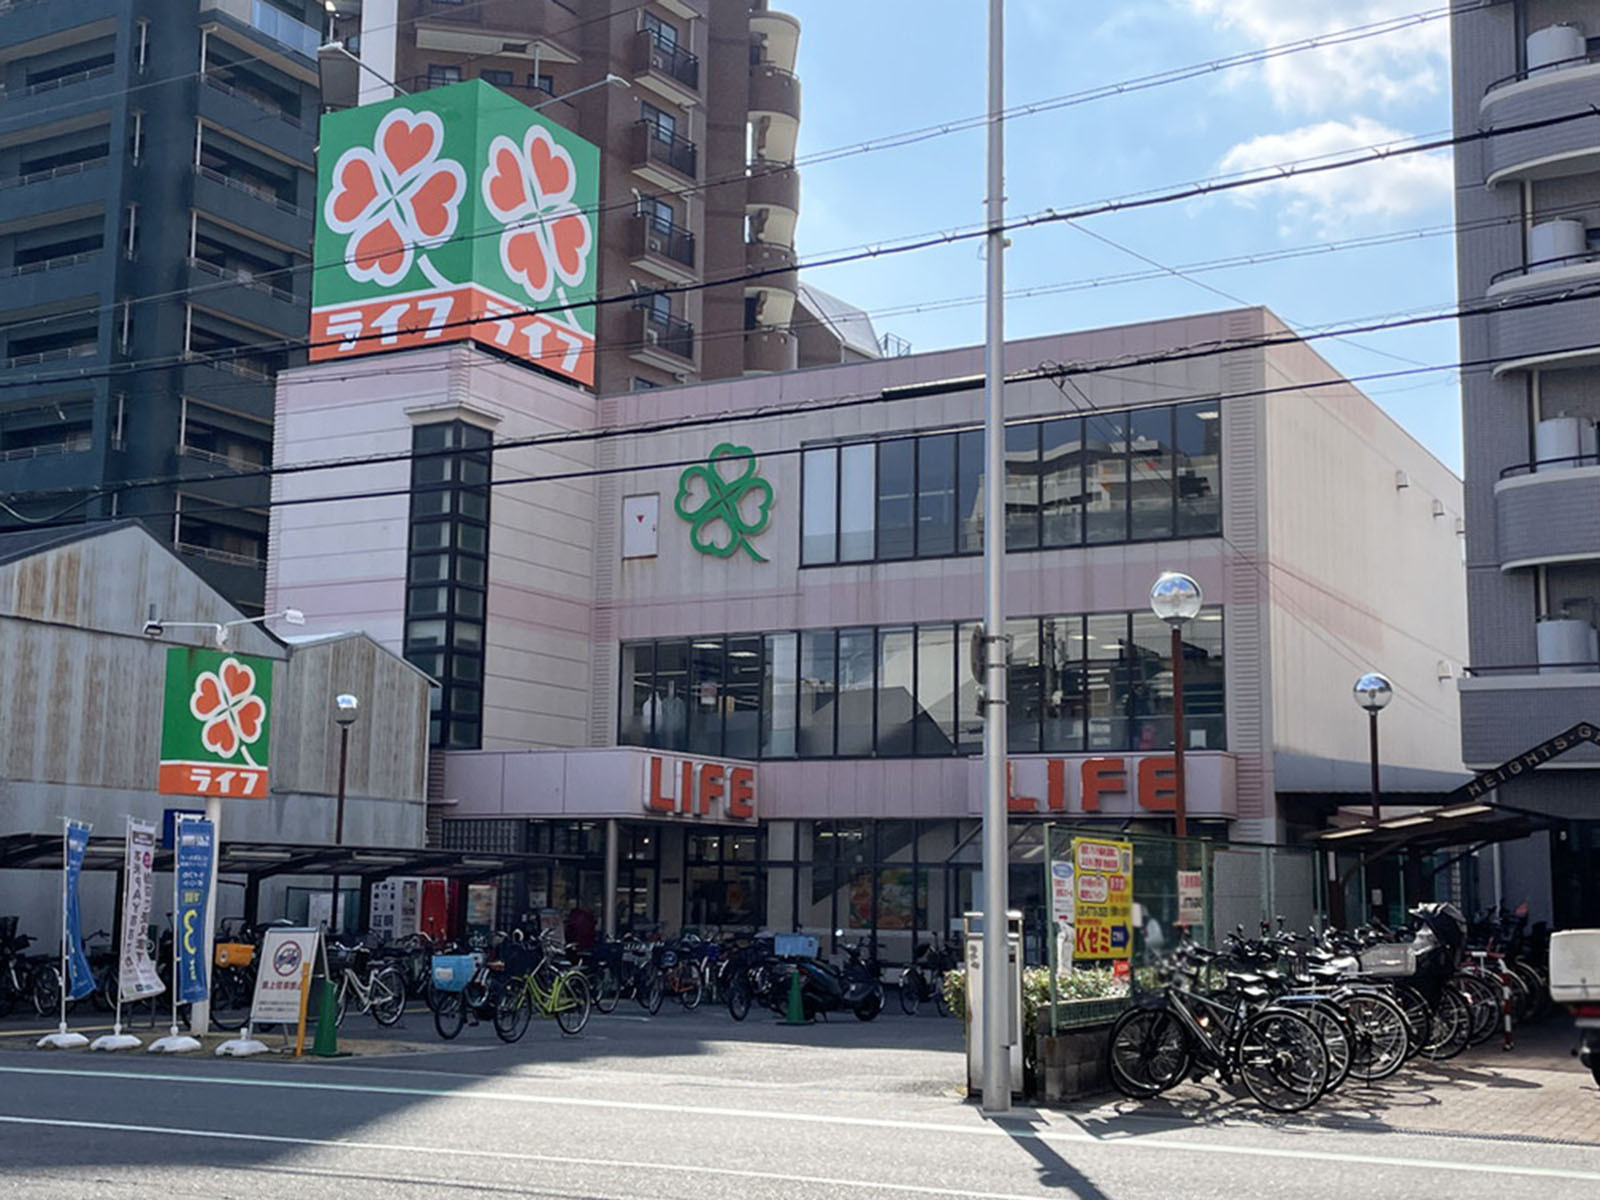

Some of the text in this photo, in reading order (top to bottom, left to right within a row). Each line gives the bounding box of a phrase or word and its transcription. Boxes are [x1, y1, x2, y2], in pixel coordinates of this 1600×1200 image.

[326, 297, 454, 351] ライフ
[485, 300, 583, 373] ライフ
[190, 768, 260, 795] ライフ
[643, 755, 755, 819] LIFE
[1468, 738, 1568, 796] HEIGHTS
[1076, 926, 1111, 954] Kゼミ
